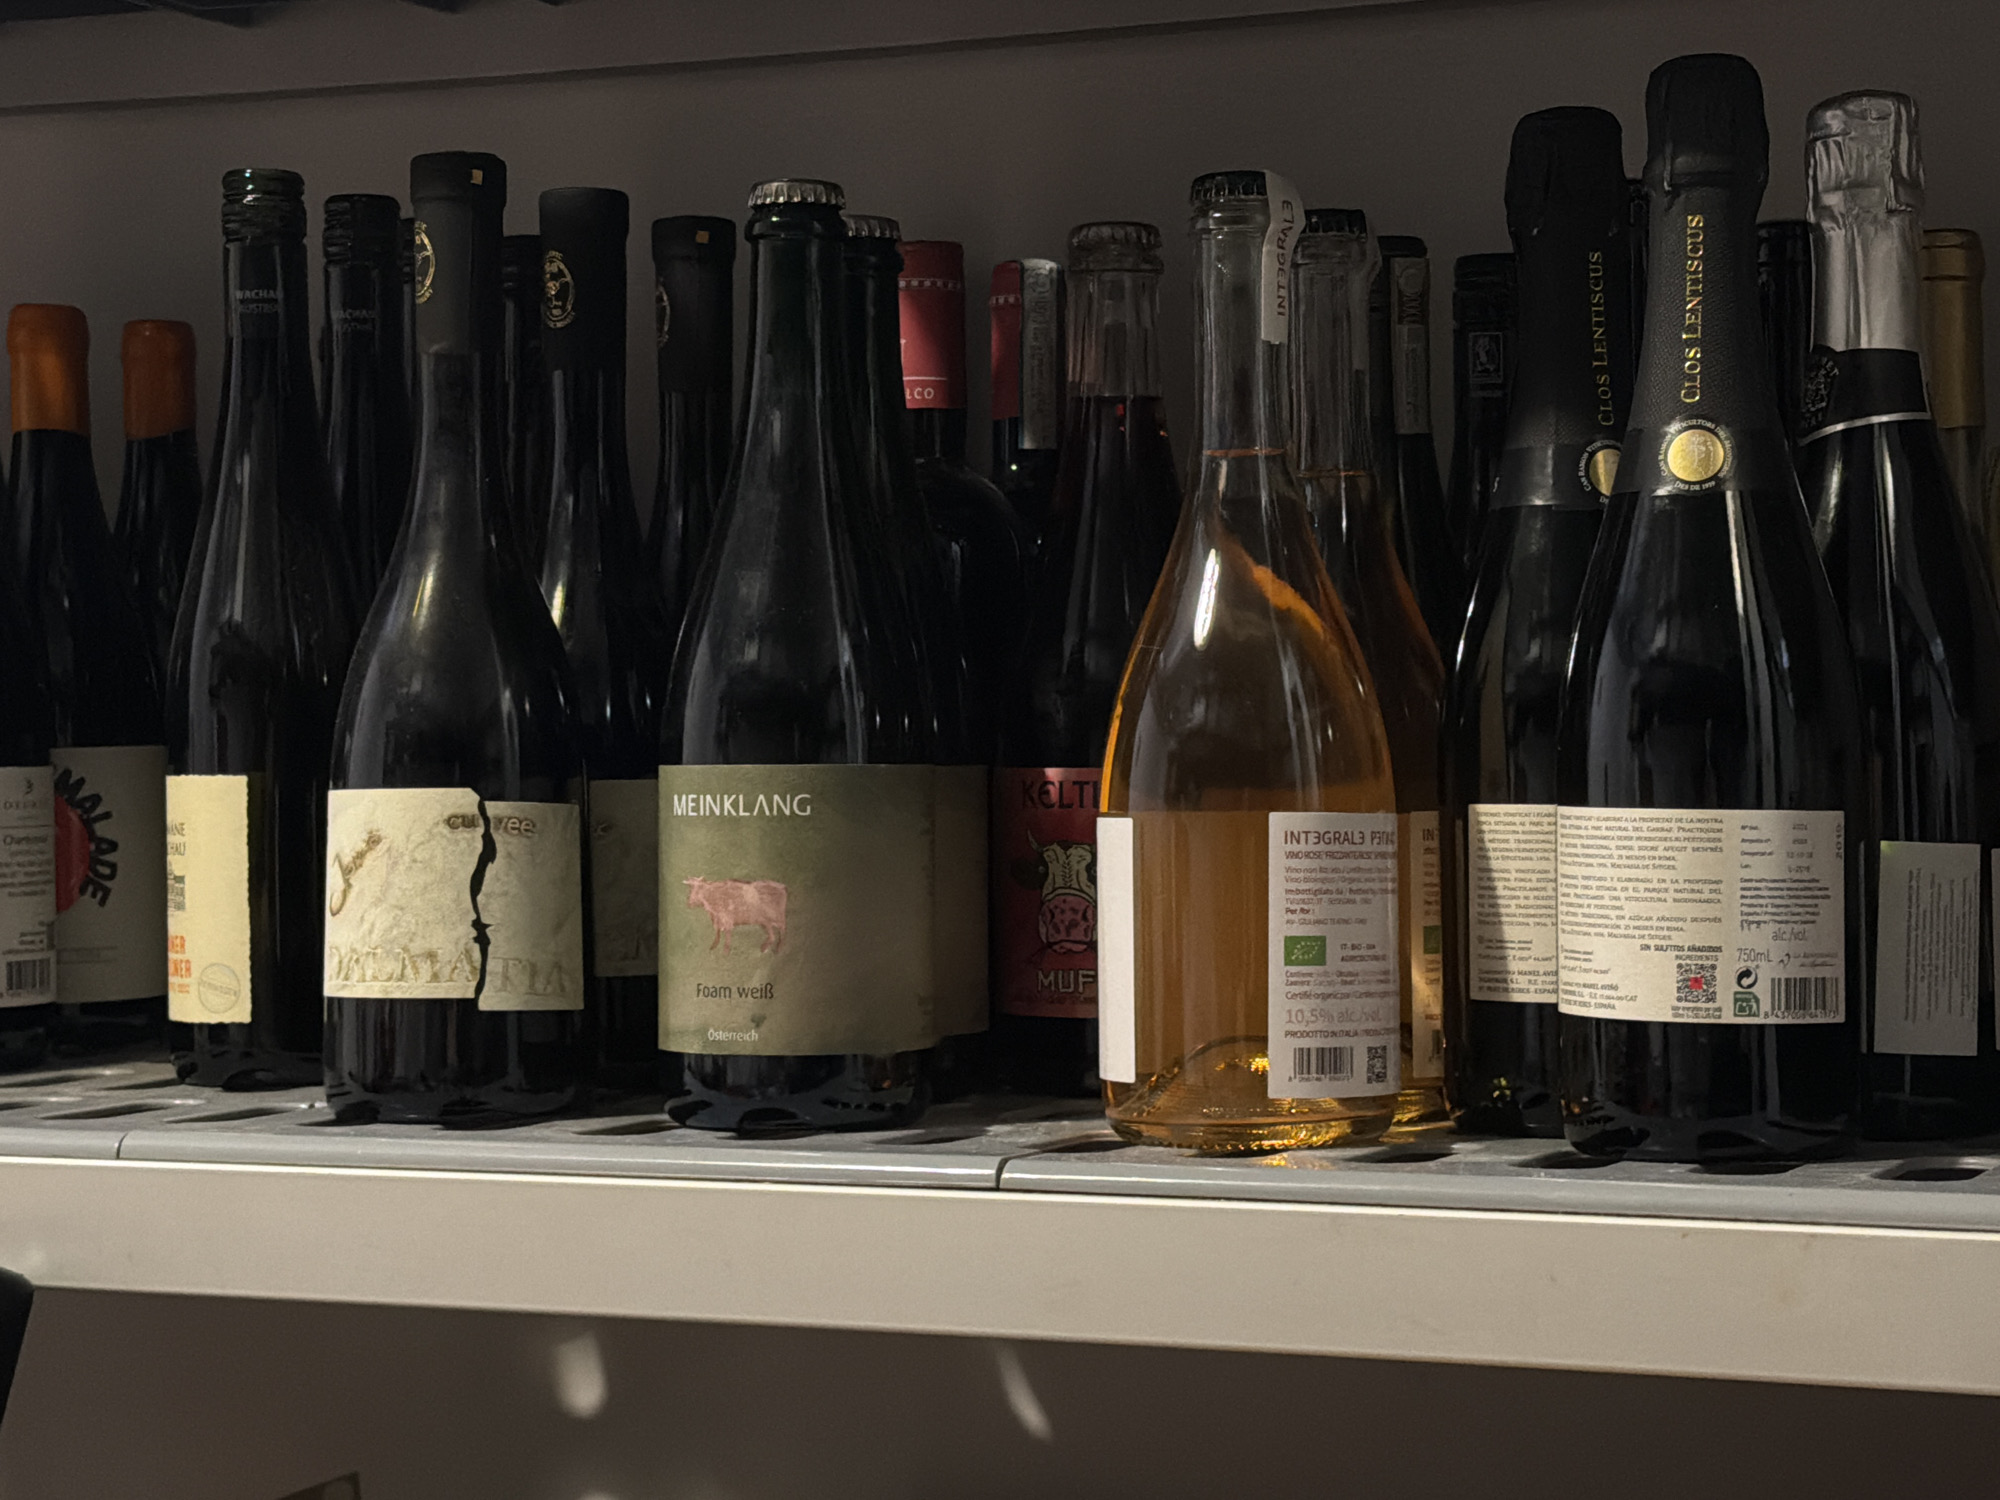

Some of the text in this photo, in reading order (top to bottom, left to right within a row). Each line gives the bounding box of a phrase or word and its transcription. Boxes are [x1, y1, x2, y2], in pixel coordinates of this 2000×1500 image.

[1680, 213, 1704, 404] CLOS LENTISCUS
[1588, 250, 1615, 427] CLOS LENTISCUS
[673, 794, 811, 816] MEINKLANG
[1639, 943, 1652, 952] SIN
[696, 982, 774, 999] Foam weiß
[707, 1028, 758, 1042] Österreich
